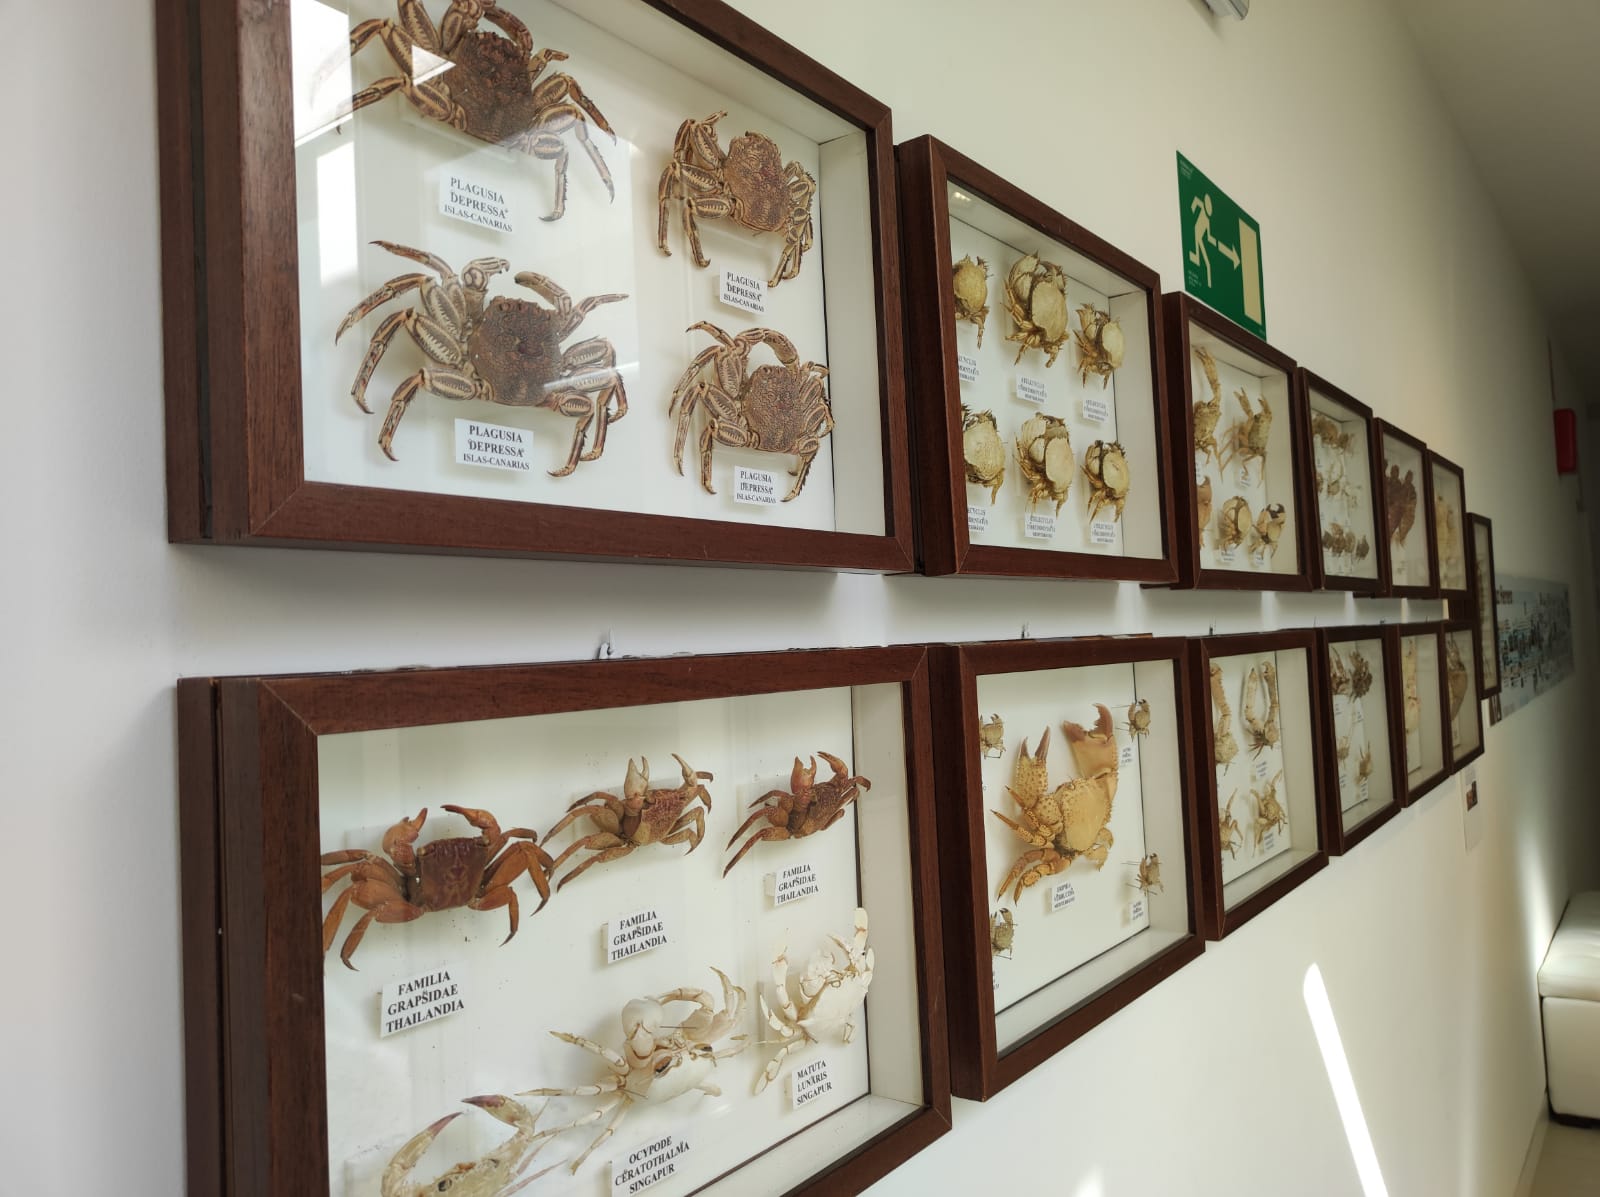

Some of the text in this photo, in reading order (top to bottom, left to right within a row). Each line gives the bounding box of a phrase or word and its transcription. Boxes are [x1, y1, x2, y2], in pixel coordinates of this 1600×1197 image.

[450, 177, 504, 204] PLAGUSIA
[450, 191, 506, 219] DEPRESSA
[444, 204, 512, 232] ISLAS-CANARIAS
[727, 272, 760, 290] PLAGUSIA
[469, 425, 522, 443] PLAGUSIA
[469, 440, 523, 458] DEPRESSA
[463, 453, 530, 470] ISLAS-CANARIAS
[740, 470, 771, 483] PLAGUSIA
[783, 864, 811, 879] FAMILIA
[777, 885, 819, 904] THAILANDIA
[620, 910, 657, 930] FAMILIA
[613, 922, 663, 946] GRAPSIDAE
[611, 935, 667, 960] THAILANDIA
[398, 971, 450, 996] FAMILIA
[387, 984, 458, 1016] GRAPSIDAE
[385, 999, 464, 1033] THAILANDIA
[797, 1060, 826, 1079] MATUTA
[797, 1081, 832, 1105] SINGAPUR
[629, 1136, 672, 1164] OCYPODE
[615, 1141, 689, 1186] CERATOTHALMA
[630, 1163, 674, 1194] SINGAPUR
